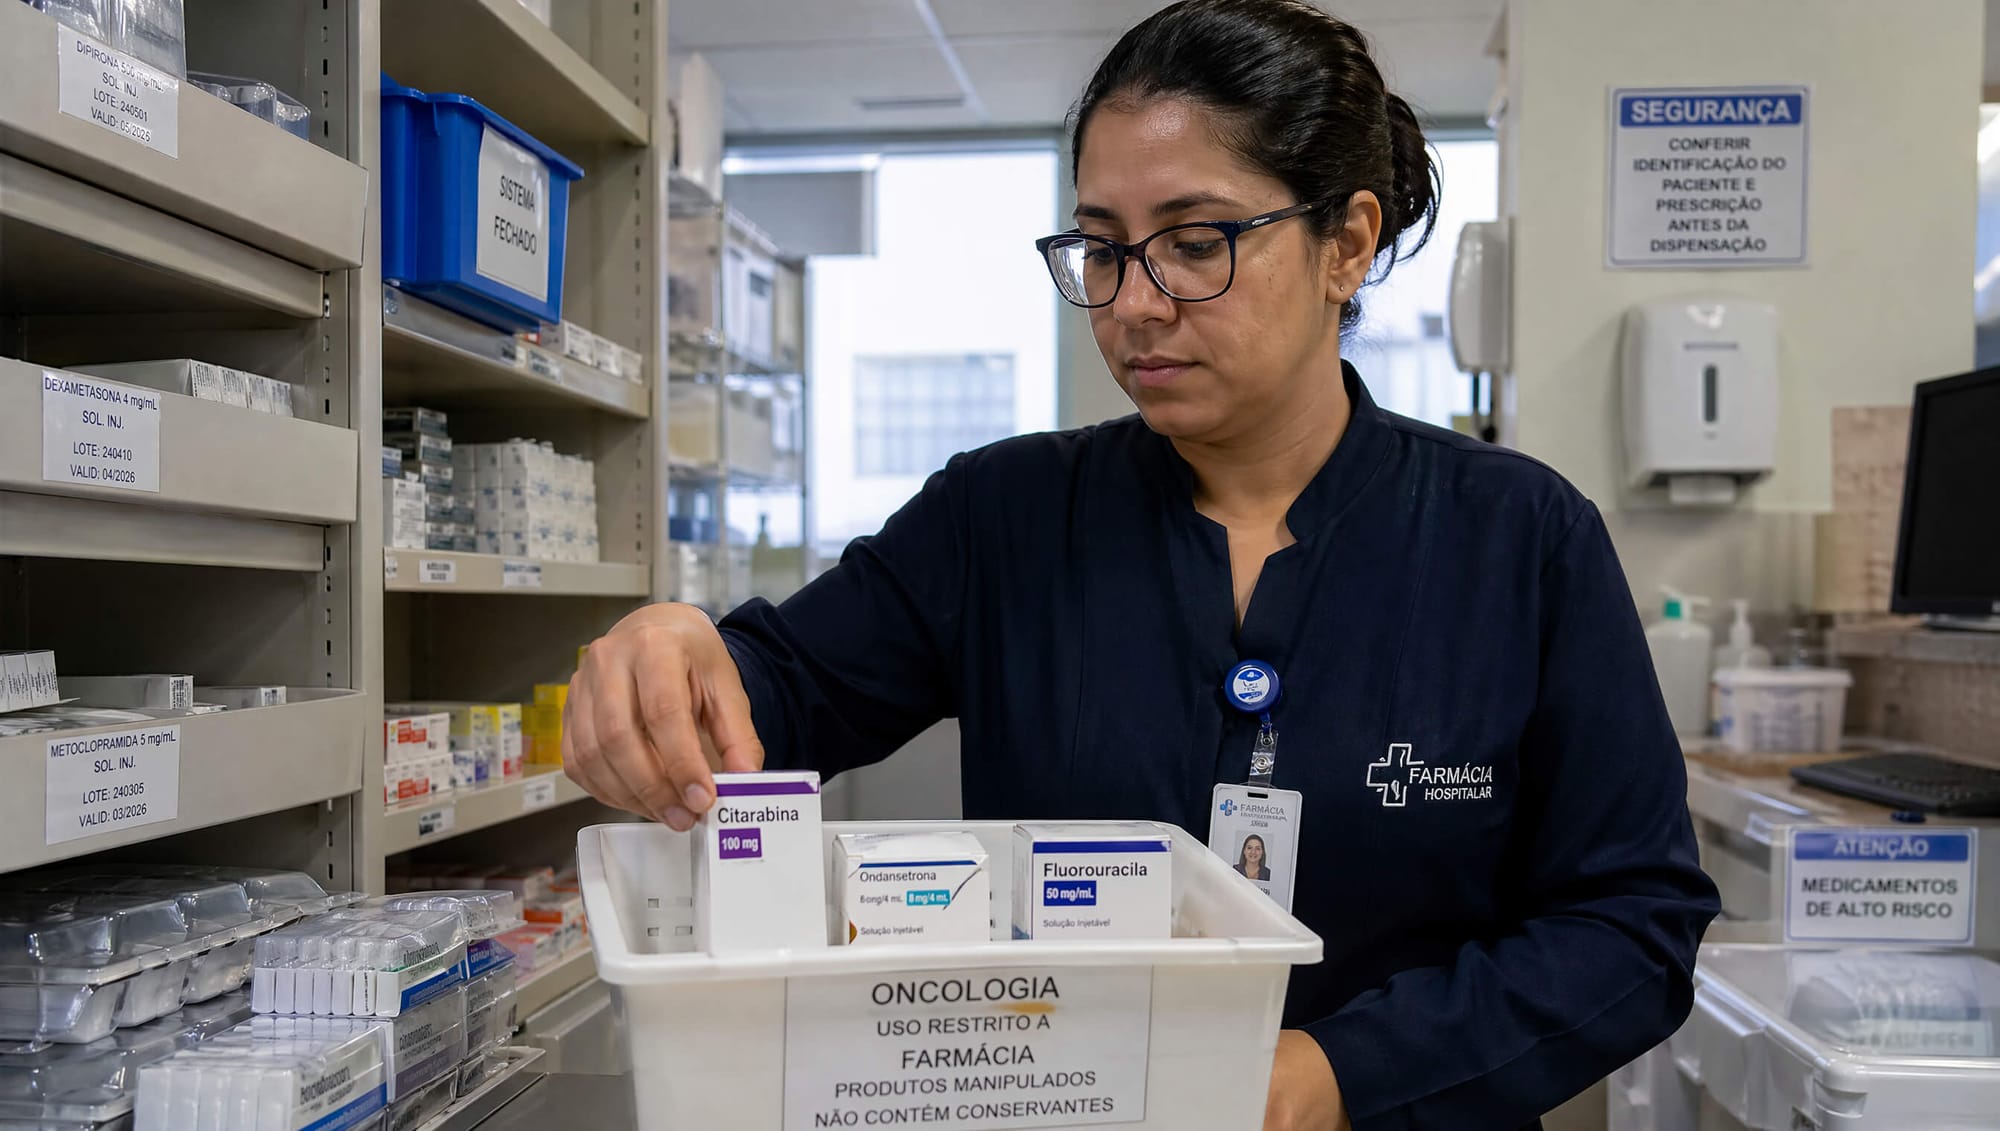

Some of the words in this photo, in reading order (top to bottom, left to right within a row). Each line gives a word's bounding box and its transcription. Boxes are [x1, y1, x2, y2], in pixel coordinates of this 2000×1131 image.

[76, 40, 120, 71] DIPIRONA
[123, 81, 139, 99] INJ.
[93, 87, 119, 109] LOTE:
[120, 100, 148, 122] 240501
[1630, 99, 1792, 126] SEGURANÇA
[91, 106, 119, 129] VALID:
[120, 120, 151, 142] 05/2026
[1668, 136, 1751, 151] CONFERIR
[1633, 154, 1758, 174] IDENTIFICAÇÃO
[1762, 156, 1787, 170] DO
[500, 175, 536, 213] SISTEMA
[1662, 178, 1741, 192] PACIENTE
[1746, 177, 1757, 191] E
[1655, 196, 1763, 214] PRESCRIÇÃO
[1668, 218, 1722, 232] ANTES
[1726, 218, 1749, 232] DA
[494, 215, 537, 256] FECHADO
[1650, 237, 1767, 254] DISPENSAÇÃO
[44, 376, 122, 404] DEXAMETASONA
[123, 393, 129, 405] 4
[130, 396, 158, 411] mg/mL
[82, 410, 105, 427] SOL.
[107, 414, 125, 430] INJ.
[73, 441, 100, 457] LOTE:
[102, 446, 132, 461] 240410
[70, 463, 100, 480] VALID:
[102, 467, 136, 483] 04/2026
[50, 735, 138, 758] METOCLOPRAMIDA
[140, 733, 146, 746] 5
[147, 730, 176, 747] mg/mL
[94, 759, 117, 773] SOL.
[119, 755, 136, 769] INJ.
[1409, 762, 1493, 784] FARMÁCIA
[82, 788, 111, 805] LOTE:
[113, 782, 145, 799] 240305
[1424, 786, 1493, 801] HOSPITALAR
[79, 810, 111, 827] VALID:
[112, 802, 147, 821] 03/2026
[717, 805, 799, 824] Citarabina
[1240, 803, 1285, 816] FARMÁCIA
[721, 836, 740, 851] 100
[741, 838, 759, 852] mg
[1833, 833, 1930, 860] ATENÇÃO
[859, 870, 937, 882] Ondansetrona
[1043, 862, 1148, 877] Fluorouracila
[1046, 887, 1059, 899] 50
[1060, 887, 1094, 902] mg/mL
[1802, 877, 1958, 895] MEDICAMENTOS
[1805, 901, 1832, 917] DE
[1836, 901, 1887, 918] ALTO
[1892, 902, 1953, 919] RISCO
[860, 926, 892, 936] Solução
[1043, 918, 1076, 929] Solução
[1076, 918, 1111, 928] Injetável
[871, 976, 1060, 1006] ONCOLOGIA
[876, 1019, 922, 1037] USO
[928, 1014, 1031, 1034] RESTRITO
[1036, 1014, 1050, 1030] A
[901, 1043, 1035, 1070] FARMÁCIA
[835, 1078, 948, 1099] PRODUTOS
[953, 1071, 1097, 1093] MANIPULADOS
[814, 1108, 859, 1129] NÃO
[864, 1103, 951, 1126] CONTÉM
[955, 1096, 1115, 1121] CONSERVANTES
